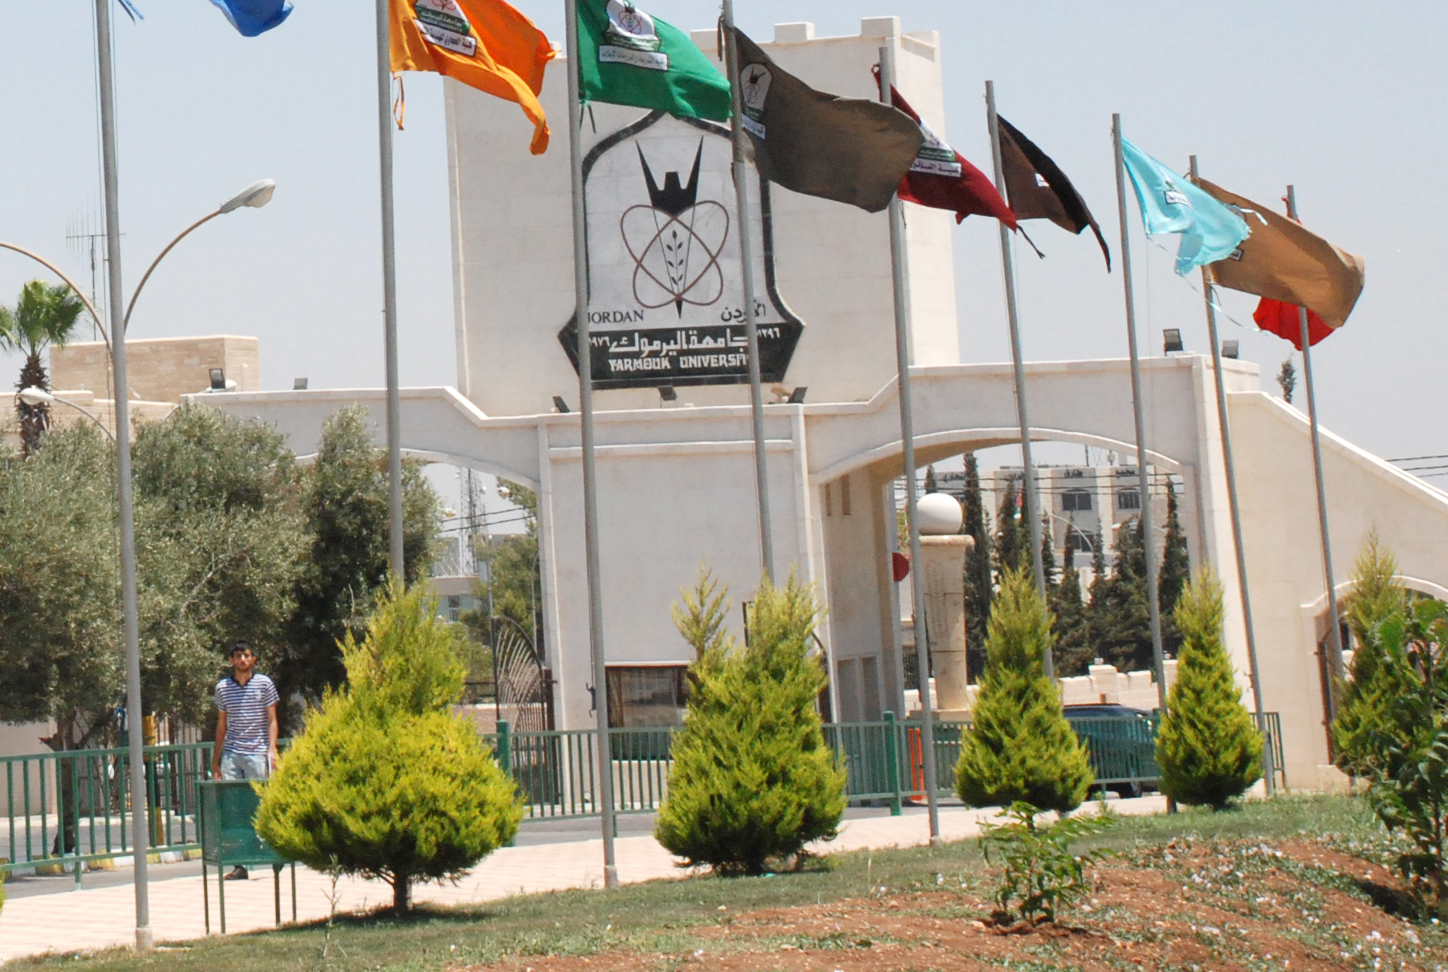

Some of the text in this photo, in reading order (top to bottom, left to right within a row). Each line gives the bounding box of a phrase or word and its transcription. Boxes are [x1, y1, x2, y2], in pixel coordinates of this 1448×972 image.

[608, 330, 687, 358] اليرموك
[608, 353, 749, 372] YARMOUK UNIVERSIT
